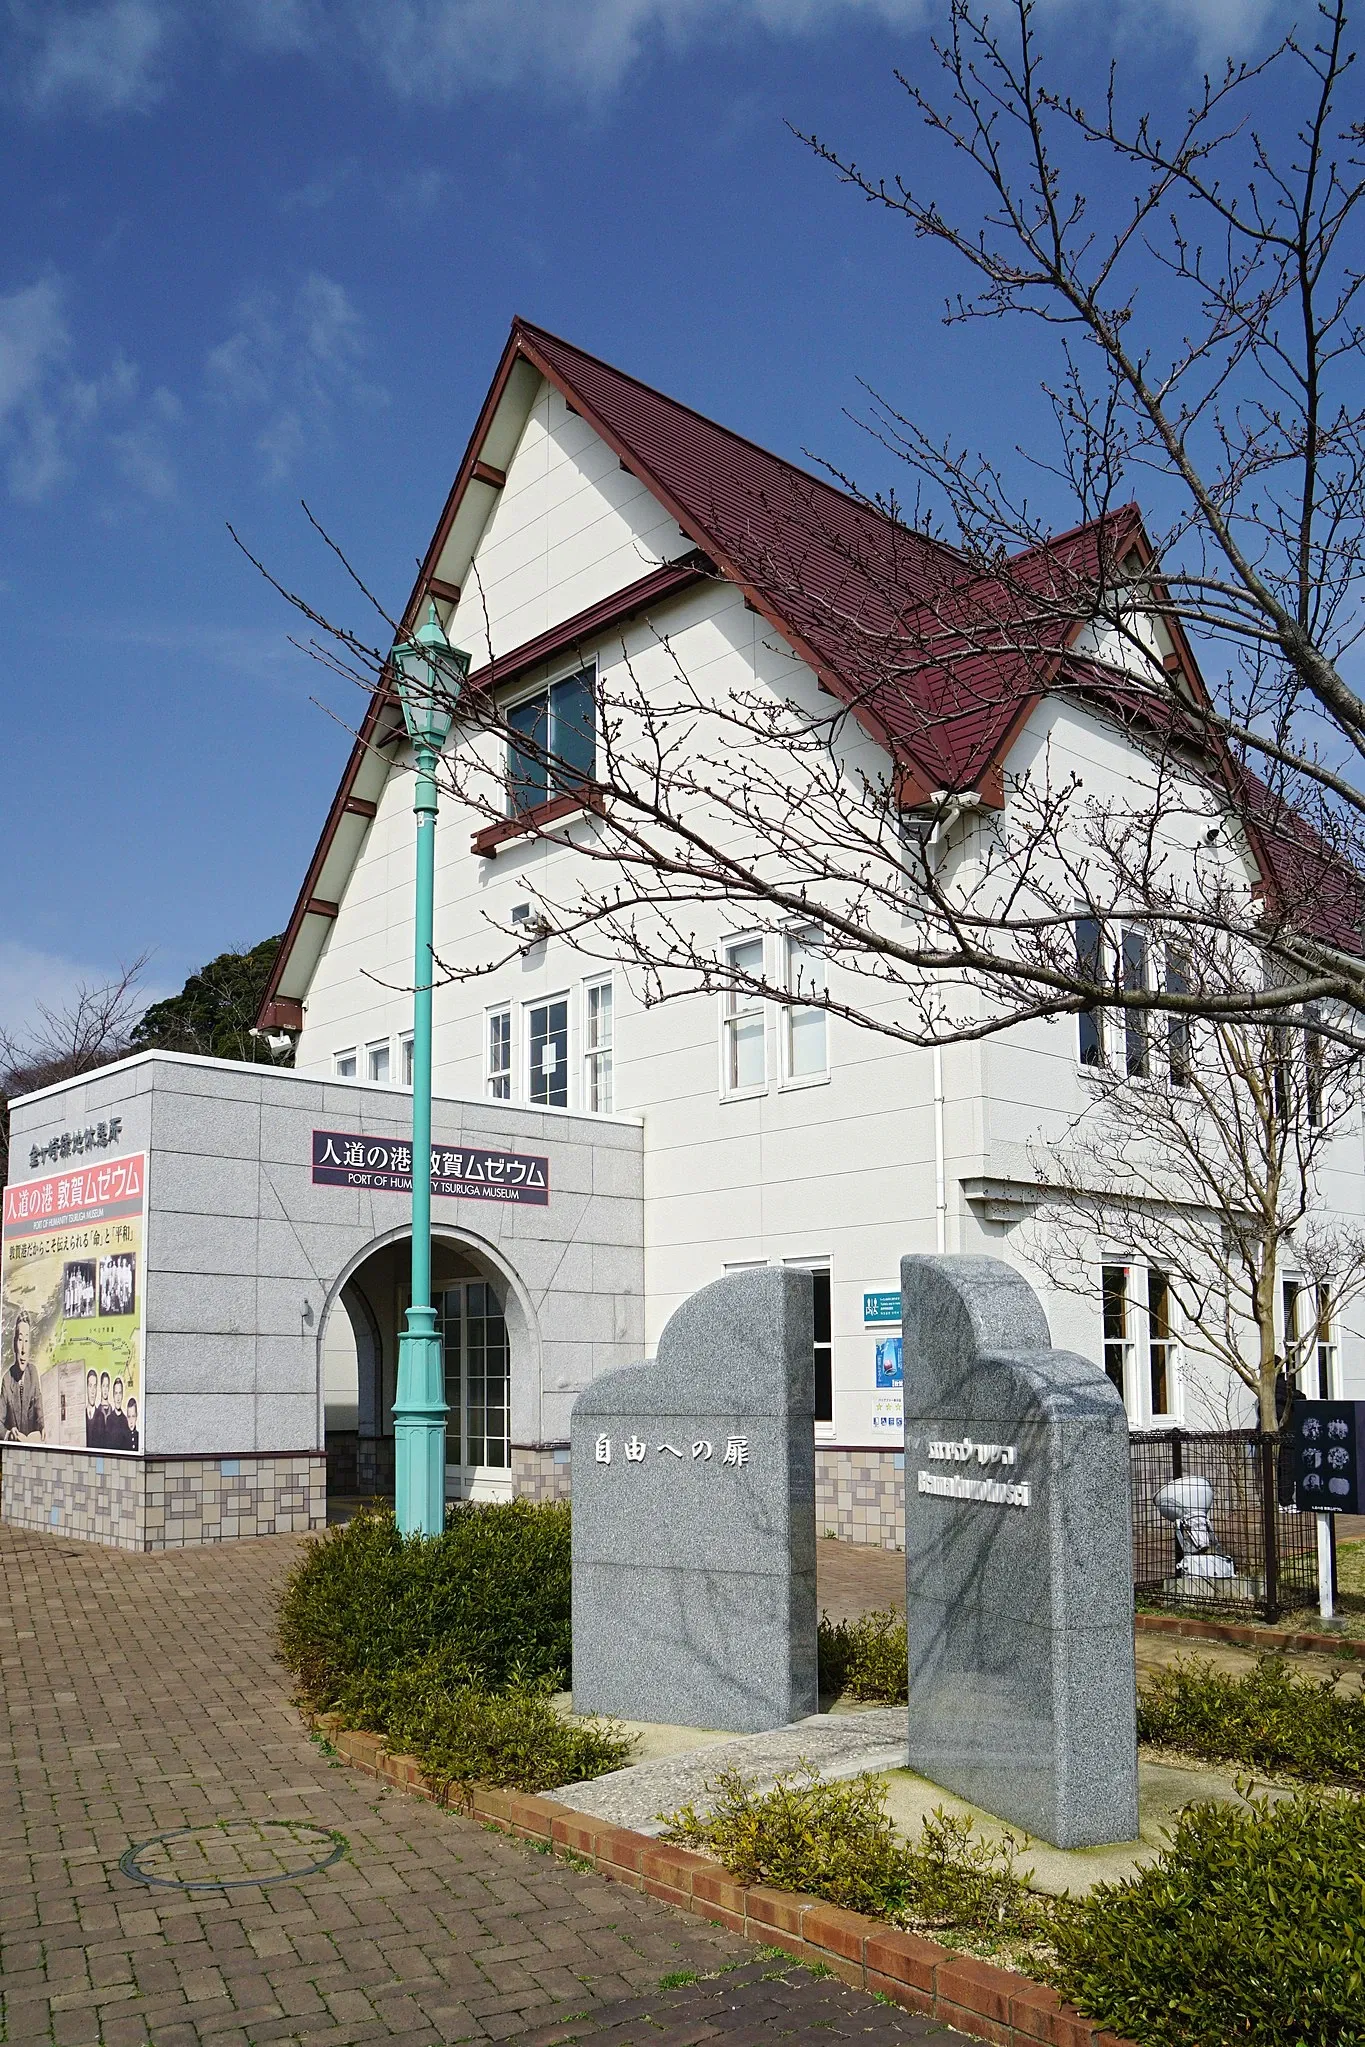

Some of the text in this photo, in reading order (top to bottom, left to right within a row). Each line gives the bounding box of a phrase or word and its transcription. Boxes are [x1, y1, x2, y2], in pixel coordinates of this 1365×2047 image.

[318, 1139, 412, 1172] 人道の港
[6, 1162, 140, 1219] 人道の港 敦賀ムゼウム
[348, 1174, 519, 1200] PORT OF HUMY TSURUGA MUSEUM
[594, 1434, 750, 1468] 自由への扉
